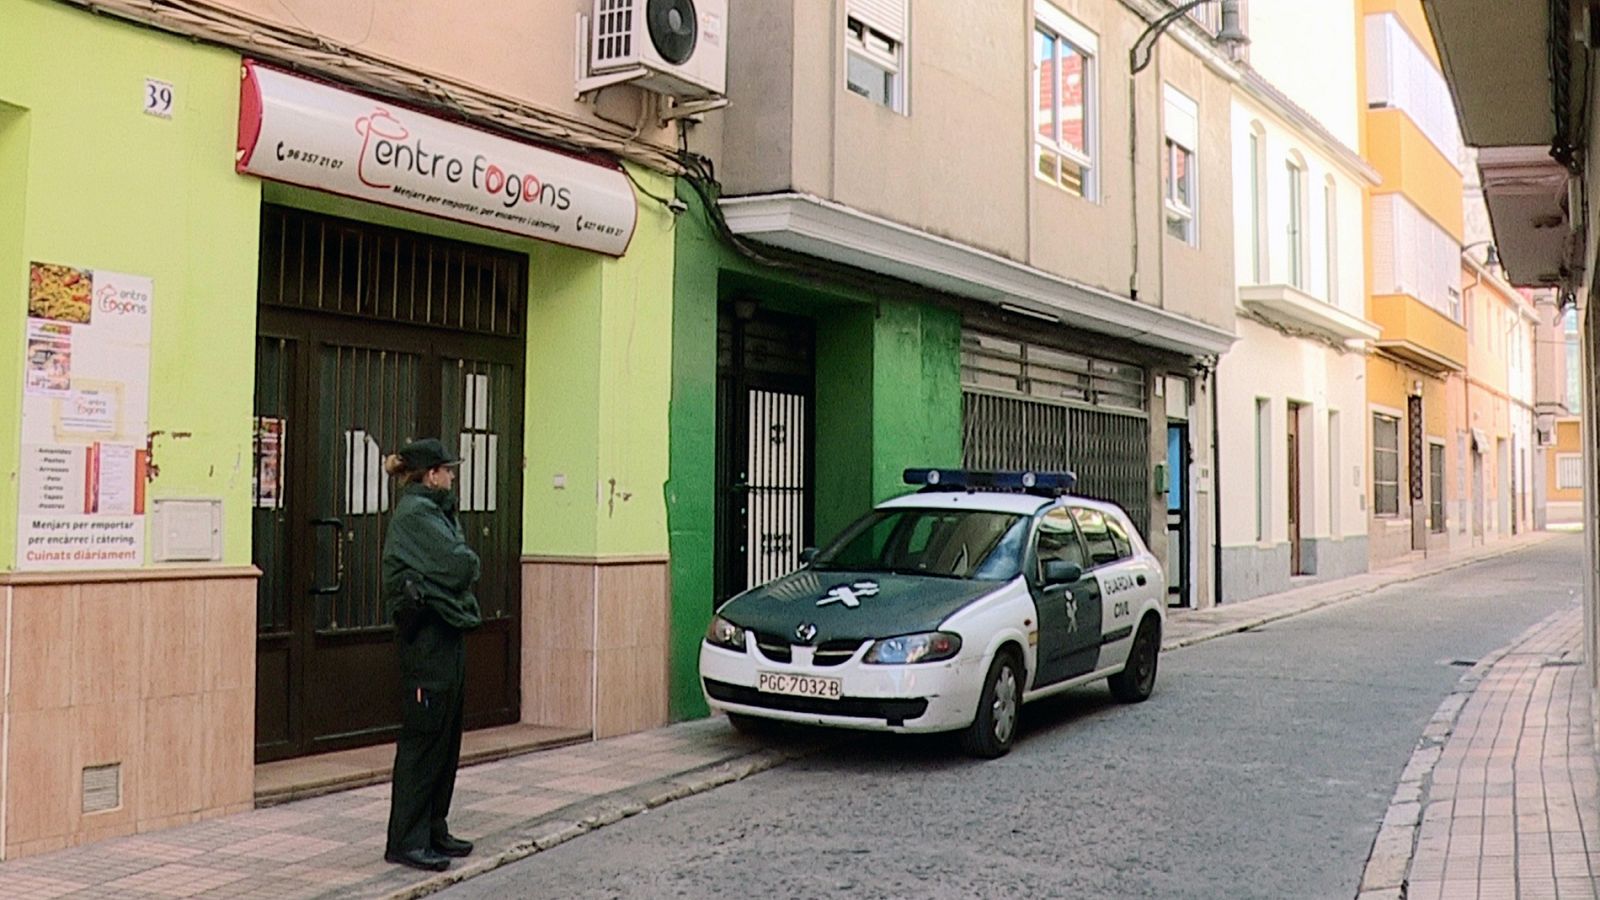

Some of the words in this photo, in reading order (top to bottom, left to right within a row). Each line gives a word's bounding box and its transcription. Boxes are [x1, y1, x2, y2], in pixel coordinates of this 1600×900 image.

[147, 84, 172, 111] 39
[287, 149, 301, 160] 96
[301, 152, 319, 164] 257
[319, 156, 330, 167] 21
[331, 158, 344, 169] 07
[375, 138, 463, 183] entre
[472, 154, 571, 210] fogons
[393, 184, 426, 199] Menjars
[426, 194, 441, 203] per
[480, 207, 494, 216] per
[120, 289, 147, 301] entre
[32, 520, 70, 531] Menjars
[72, 522, 88, 530] per
[91, 520, 134, 530] emportar
[28, 536, 45, 546] per
[26, 550, 71, 561] Cuinats
[1104, 575, 1134, 595] GUARDIA
